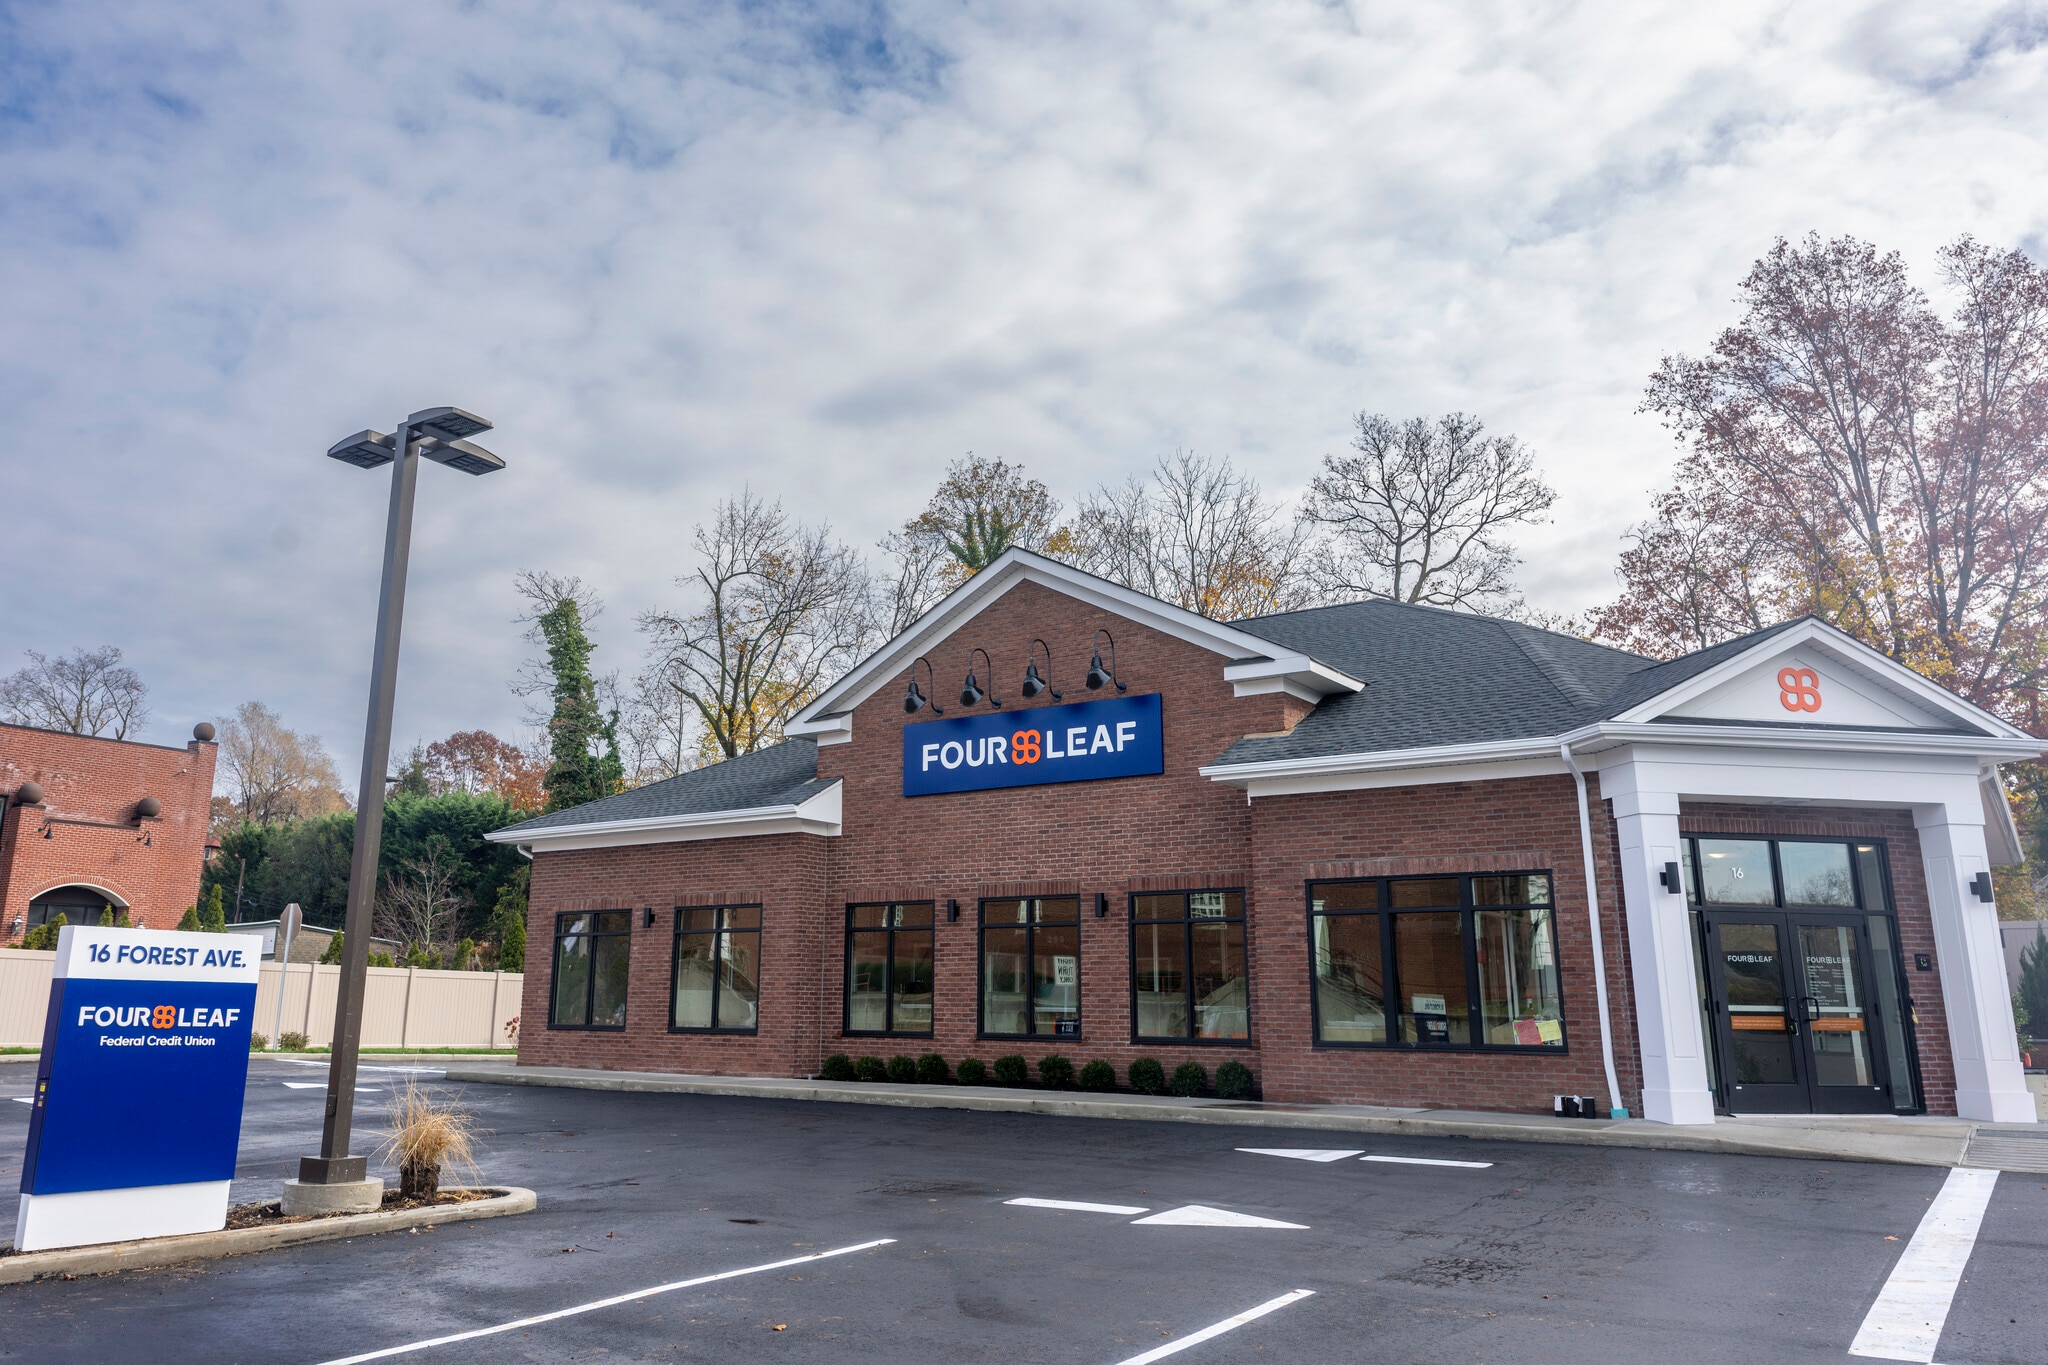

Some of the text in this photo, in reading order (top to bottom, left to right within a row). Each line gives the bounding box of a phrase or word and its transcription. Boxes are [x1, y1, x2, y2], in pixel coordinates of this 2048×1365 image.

[922, 721, 1136, 772] FOUR LEAF
[1731, 867, 1744, 879] 16
[89, 943, 247, 968] 16 FOREST AVE.
[78, 1006, 240, 1027] FOUR LEAF
[100, 1036, 215, 1046] Federal Credit Union
